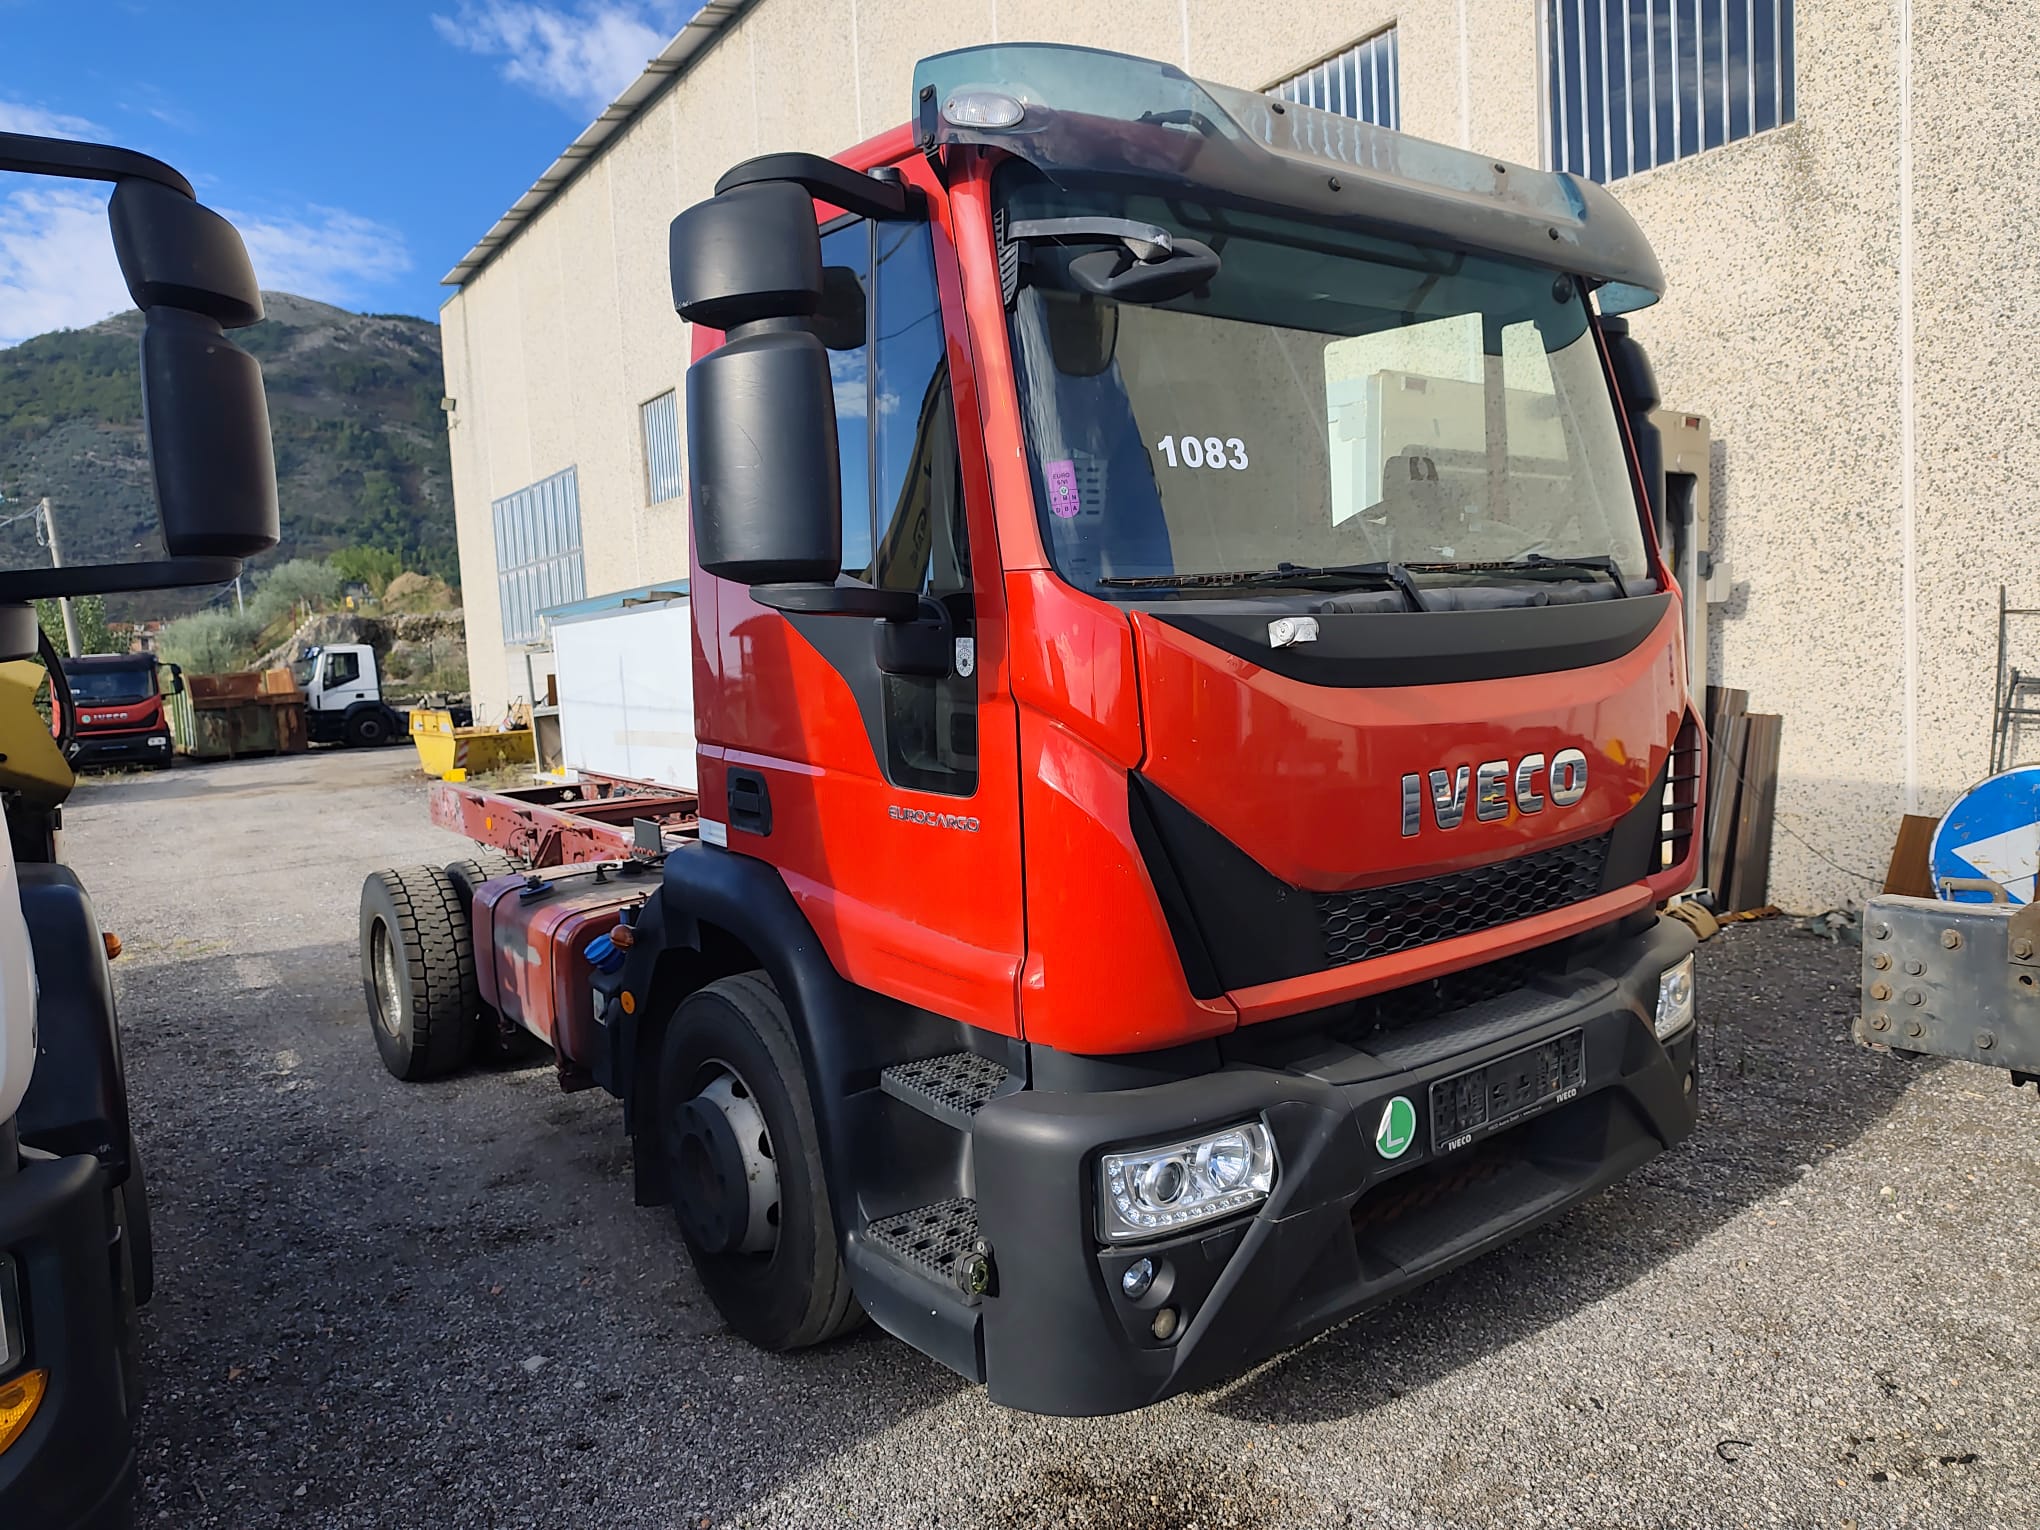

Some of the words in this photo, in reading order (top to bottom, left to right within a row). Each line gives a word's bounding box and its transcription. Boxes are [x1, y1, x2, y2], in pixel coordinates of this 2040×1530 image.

[1157, 435, 1249, 470] 1083
[1401, 747, 1588, 838] IVECO
[888, 805, 981, 833] EUROCARGO
[1556, 1088, 1577, 1104] IVECO
[1386, 1119, 1404, 1148] L
[1448, 1134, 1472, 1151] IVECO
